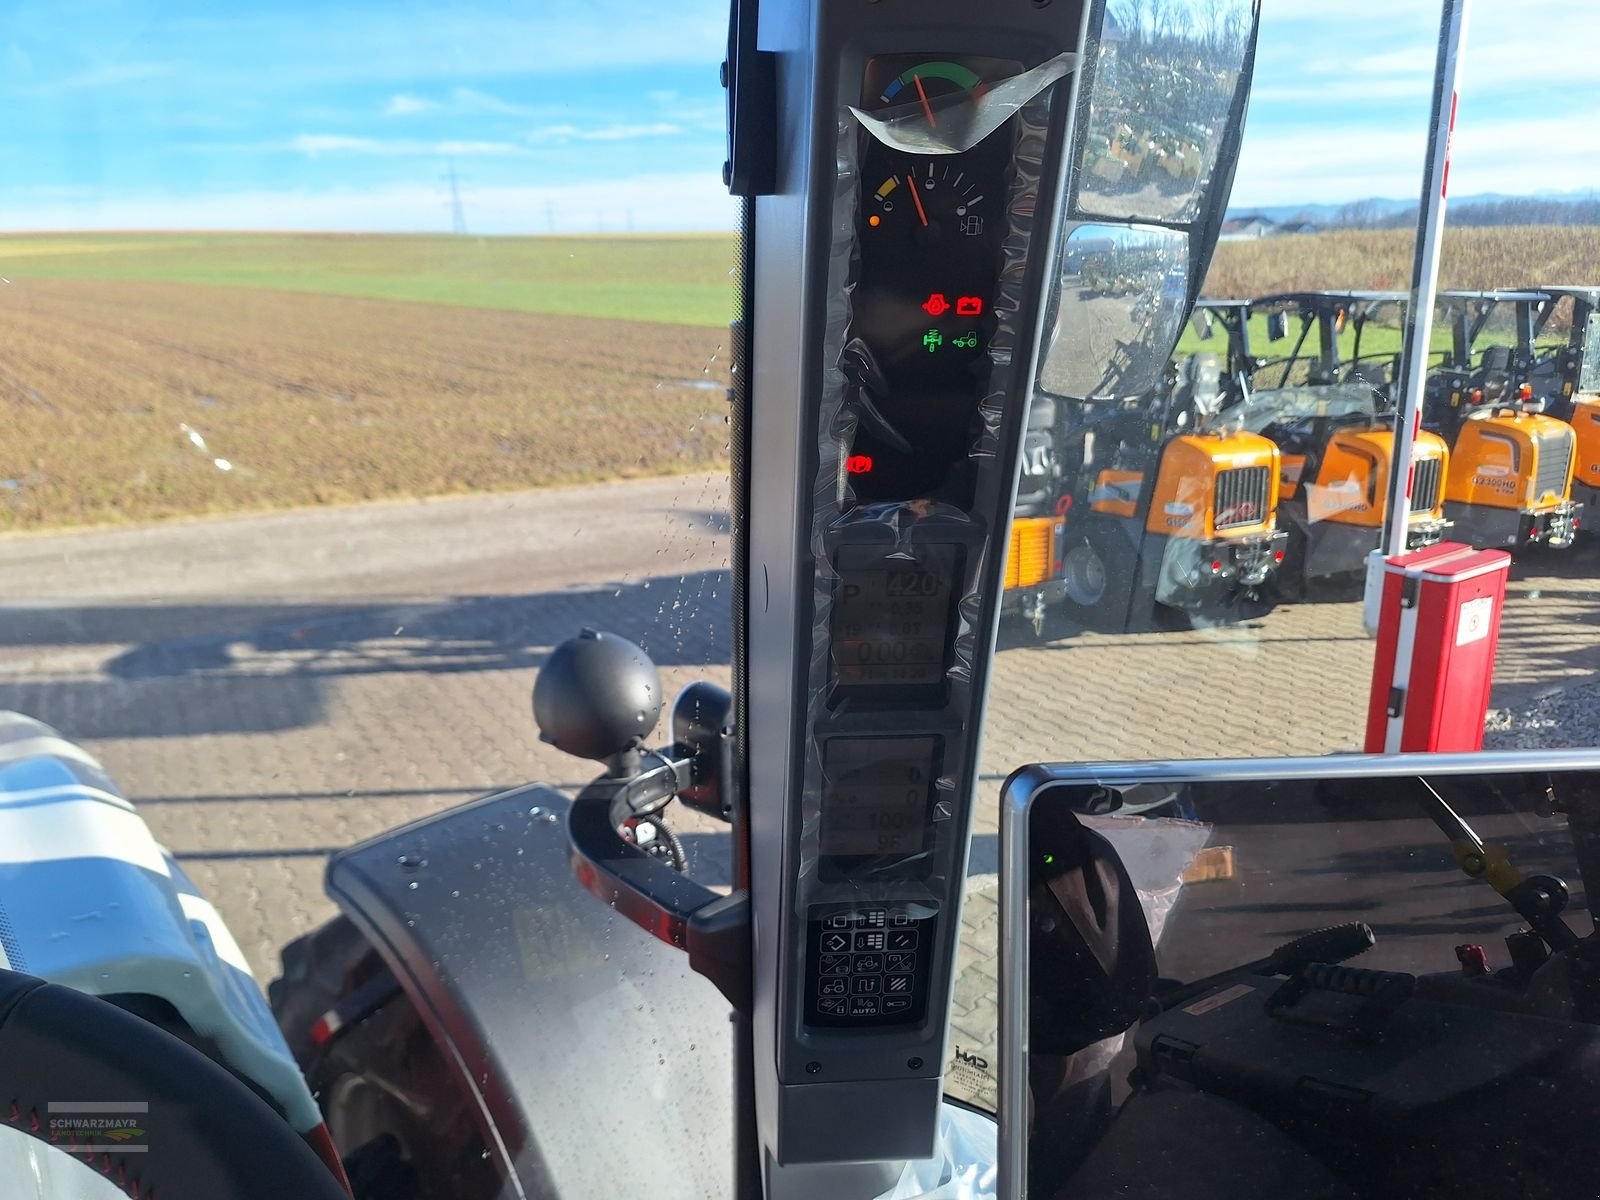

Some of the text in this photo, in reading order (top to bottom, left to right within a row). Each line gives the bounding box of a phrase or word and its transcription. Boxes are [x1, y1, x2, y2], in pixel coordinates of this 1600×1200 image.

[888, 572, 937, 595] 420
[843, 584, 861, 606] P
[852, 1007, 877, 1015] AUTO
